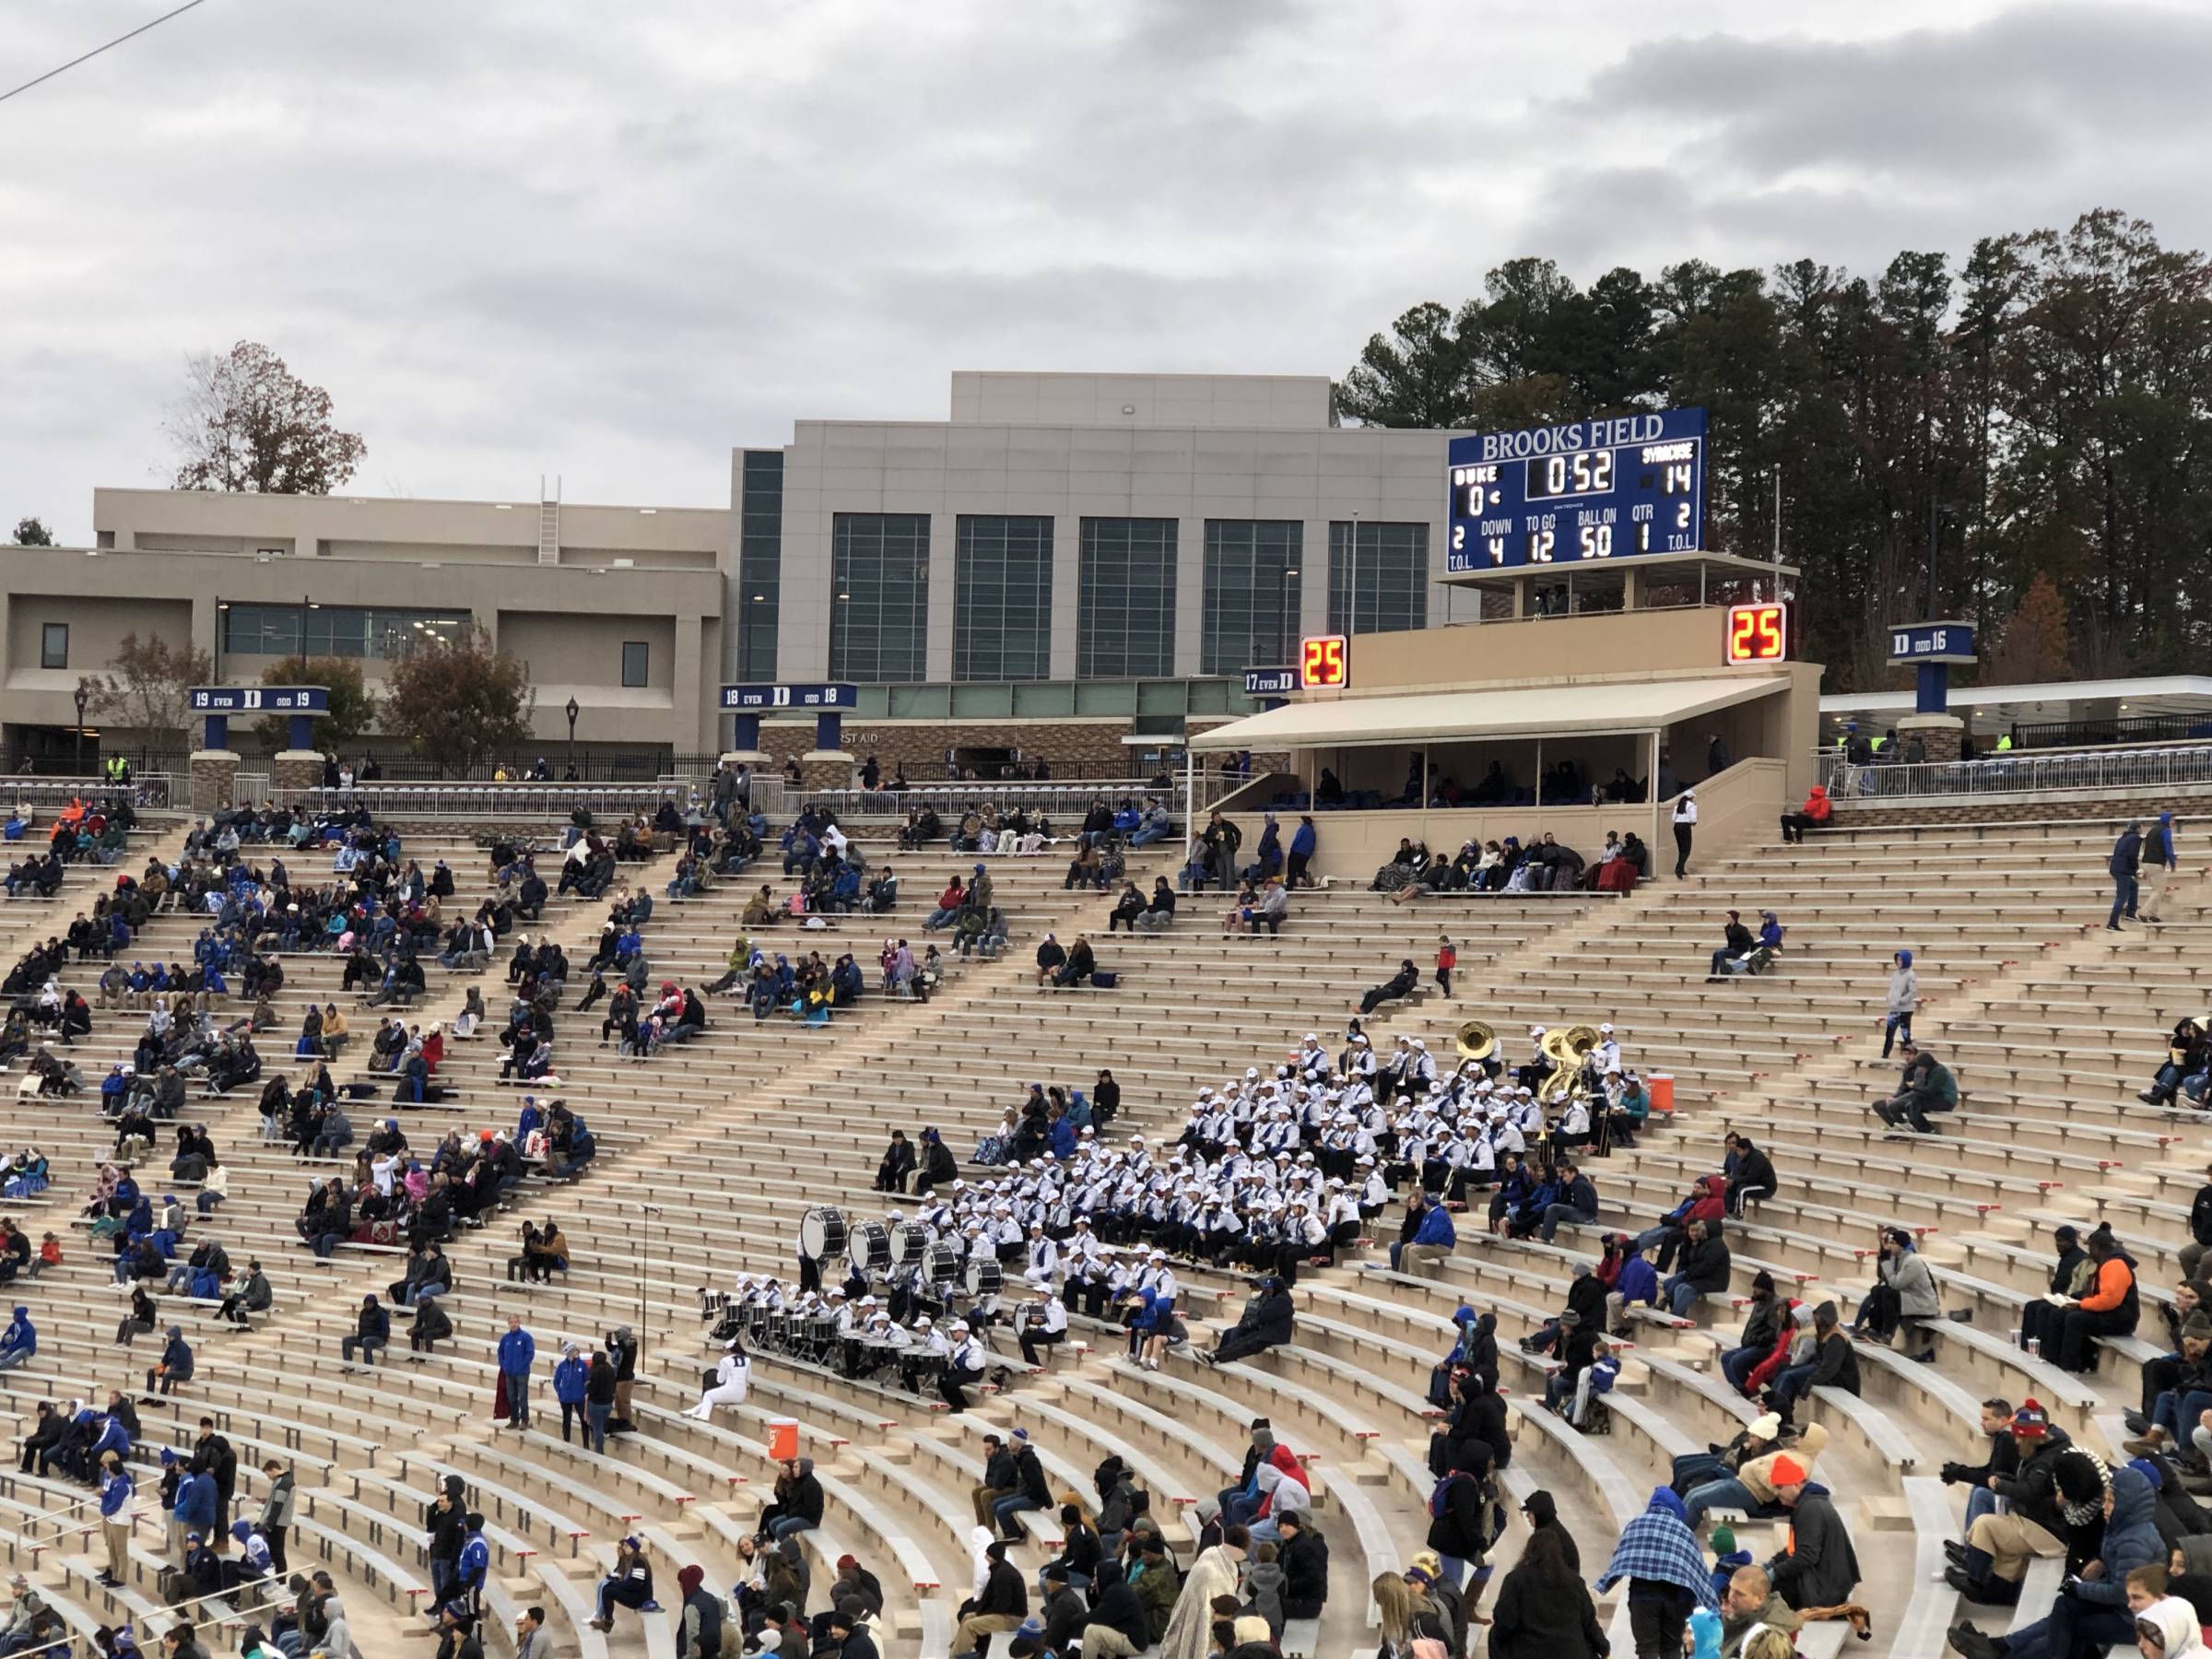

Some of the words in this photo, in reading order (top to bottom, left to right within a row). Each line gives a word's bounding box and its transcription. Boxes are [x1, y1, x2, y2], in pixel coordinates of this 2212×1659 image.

[1482, 424, 1583, 461] BROOKS
[1590, 415, 1664, 448] FIELD
[1454, 465, 1497, 486] DUKE
[1548, 452, 1611, 493] 0:52
[1667, 464, 1691, 494] 14
[1469, 486, 1484, 516] 0
[1632, 503, 1653, 522] QTR
[1481, 518, 1512, 536] DOWN
[1526, 515, 1539, 531] TO
[1542, 513, 1556, 530] GO
[1578, 509, 1601, 526] BALL
[1603, 508, 1617, 524] ON
[1677, 502, 1690, 528] 2
[1453, 525, 1465, 550] 2
[1532, 531, 1555, 561] 12
[1582, 525, 1612, 558] 50
[1642, 523, 1649, 550] 1
[1489, 537, 1503, 563] 4
[1734, 609, 1780, 657] 25
[1915, 640, 1931, 653] ODD
[1933, 630, 1947, 651] 16
[1305, 641, 1342, 683] 25
[1246, 674, 1258, 690] 17
[1259, 679, 1277, 690] EVEN
[195, 692, 208, 707] 19
[214, 697, 233, 706] EVEN
[276, 698, 292, 706] ODD
[297, 692, 310, 707] 19
[726, 689, 738, 705] 18
[744, 695, 762, 704] EVEN
[805, 694, 819, 703] ODD
[824, 688, 837, 703] 18
[859, 733, 878, 744] AID
[731, 1356, 746, 1367] D
